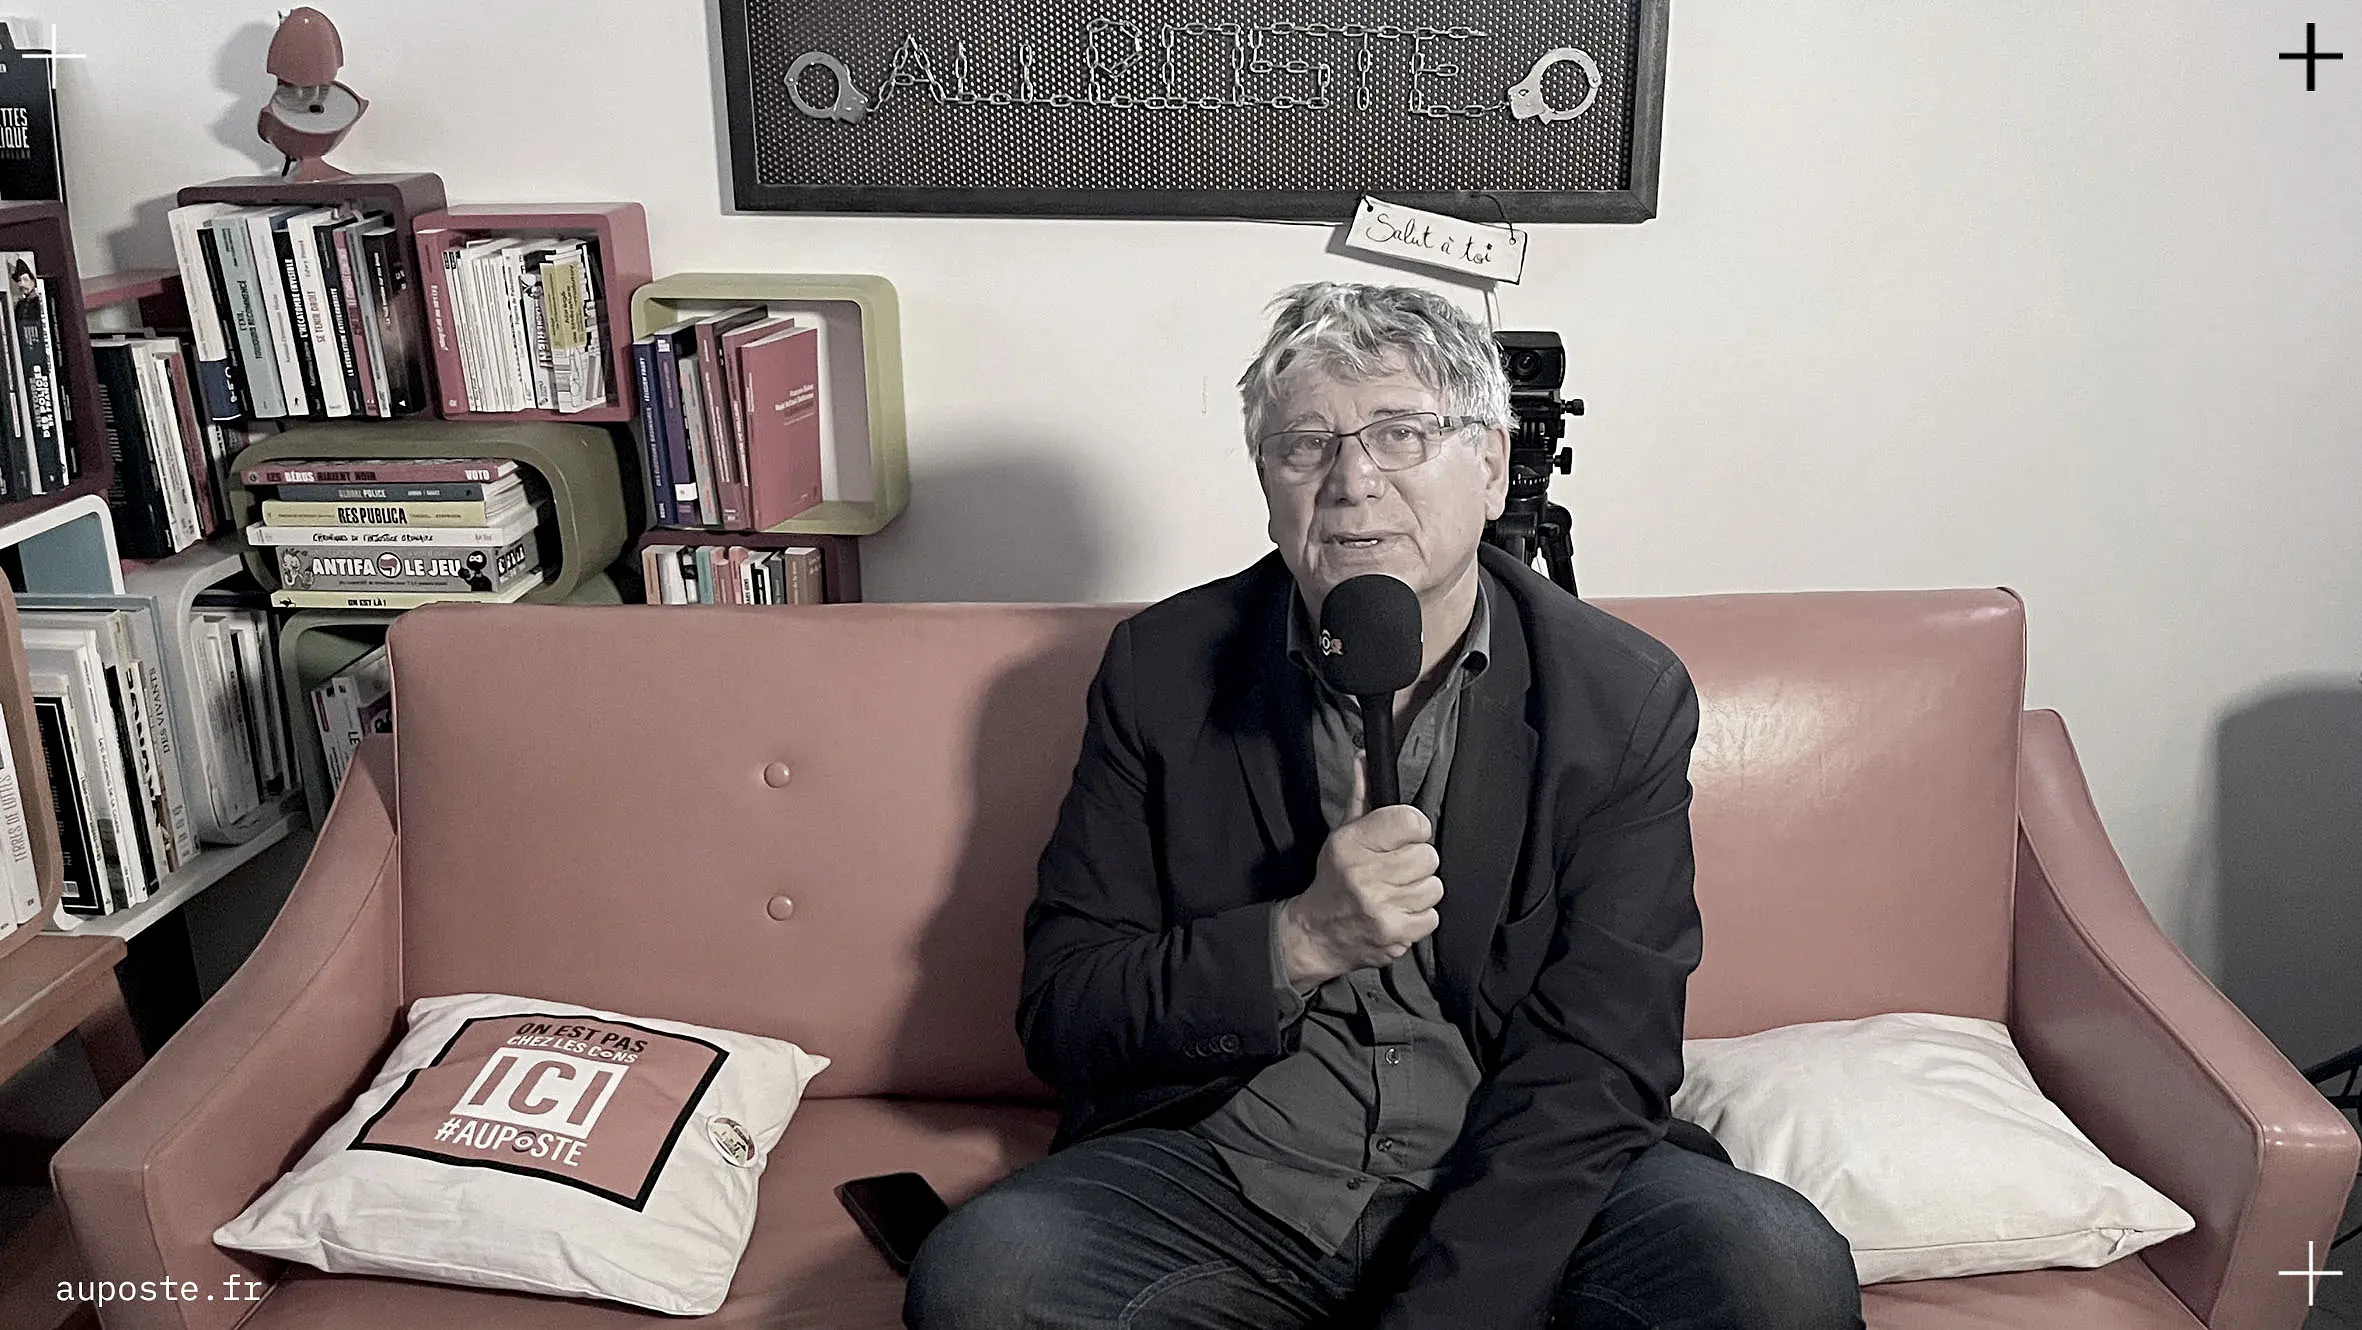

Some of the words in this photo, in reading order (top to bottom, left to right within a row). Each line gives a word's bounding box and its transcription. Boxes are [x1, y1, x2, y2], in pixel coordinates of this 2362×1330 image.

[1365, 212, 1434, 249] Salut
[1440, 236, 1454, 255] à
[1459, 235, 1493, 265] toi
[284, 258, 299, 292] INVISIBLE
[237, 279, 256, 327] RECOMMENCÉ
[291, 292, 309, 338] L'HÉCATOMBE
[307, 290, 319, 312] DROIT
[316, 332, 325, 343] SE
[339, 335, 353, 368] RÉVOLUTION
[33, 365, 47, 413] POLICES
[42, 376, 52, 408] FRANCE
[40, 414, 51, 438] DES
[46, 411, 54, 426] EN
[284, 471, 315, 482] BÉRUS
[354, 472, 376, 480] NOIR
[465, 470, 490, 480] VOTO
[363, 489, 386, 498] POLICE
[312, 557, 376, 576] ANTIFA
[404, 559, 424, 576] LE
[428, 560, 462, 577] JEU
[146, 667, 168, 727] VIVANTS
[158, 728, 171, 753] DES
[0, 774, 18, 810] LUTTES
[5, 813, 20, 825] DE
[8, 826, 28, 862] TERRES
[506, 1034, 550, 1049] CHEZ
[552, 1037, 585, 1054] LES
[516, 1021, 547, 1037] ON
[556, 1024, 598, 1041] EST
[601, 1031, 649, 1055] PAS
[469, 1055, 615, 1125] ICI
